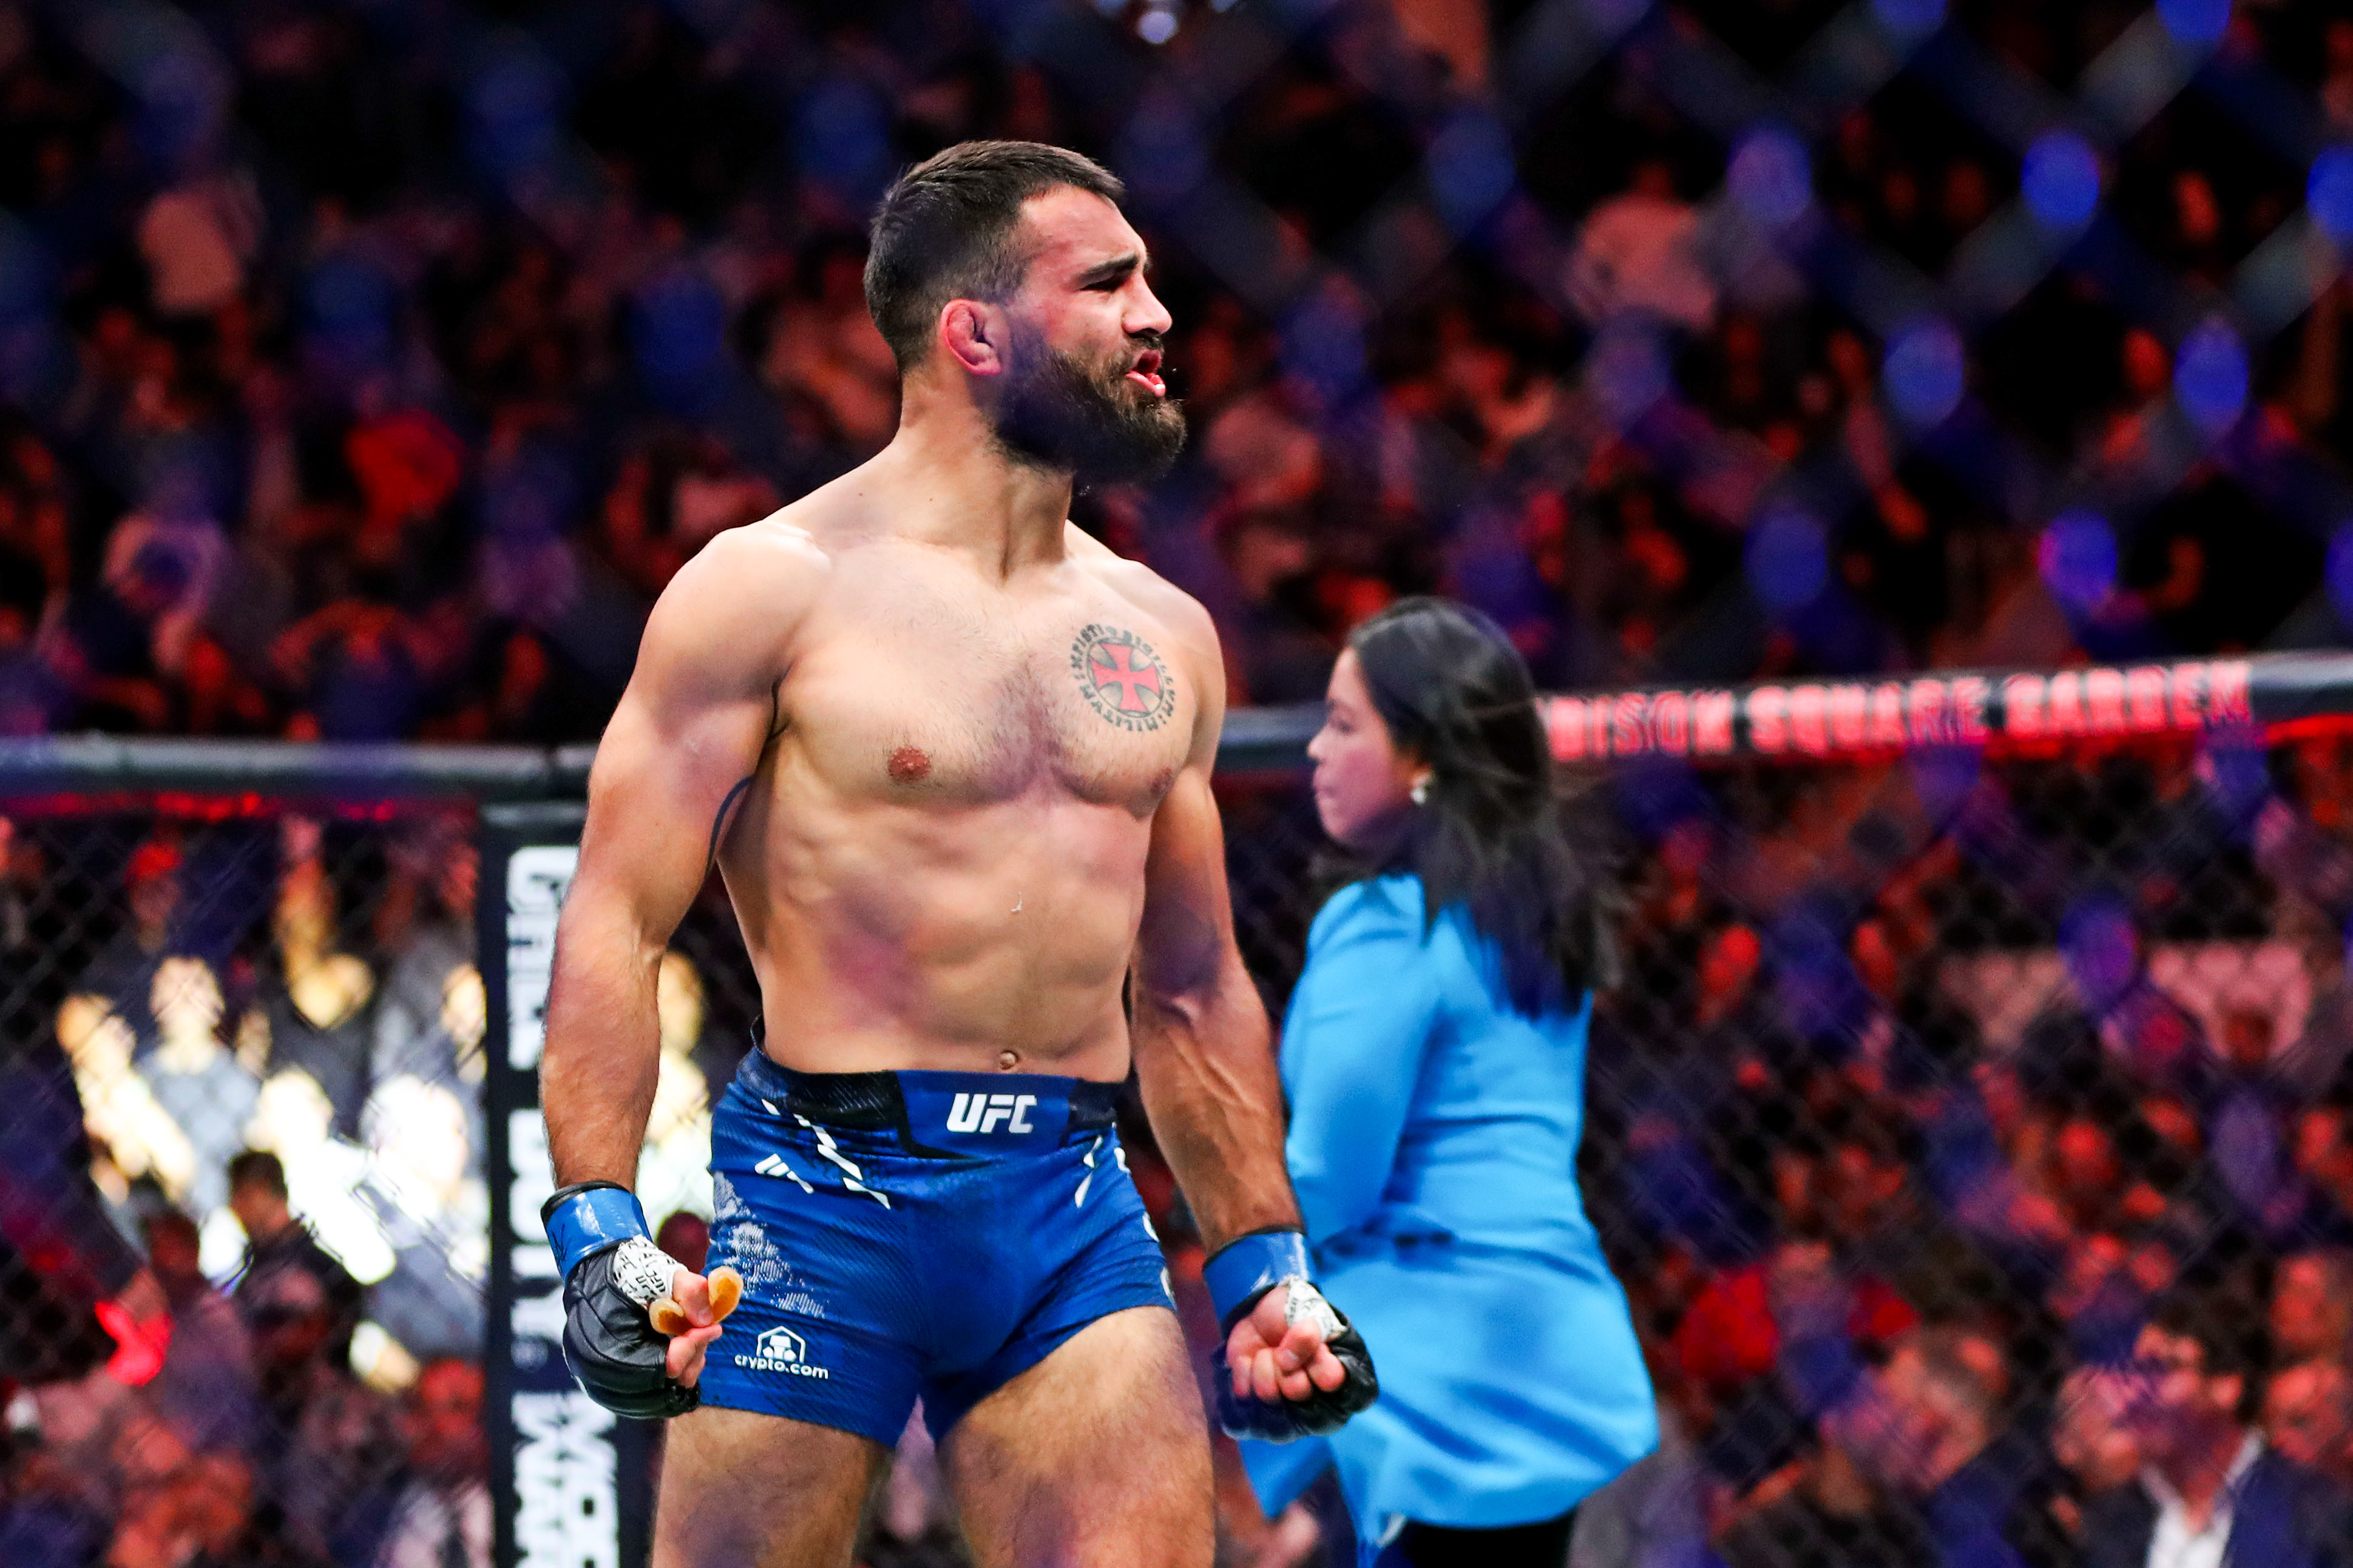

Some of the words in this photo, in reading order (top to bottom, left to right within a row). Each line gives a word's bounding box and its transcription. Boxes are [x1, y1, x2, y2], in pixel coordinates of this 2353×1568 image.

[1542, 692, 1732, 760] DISON
[1748, 680, 1988, 755] SQUARE
[946, 1093, 1037, 1134] UFC
[734, 1354, 828, 1379] crypto.com
